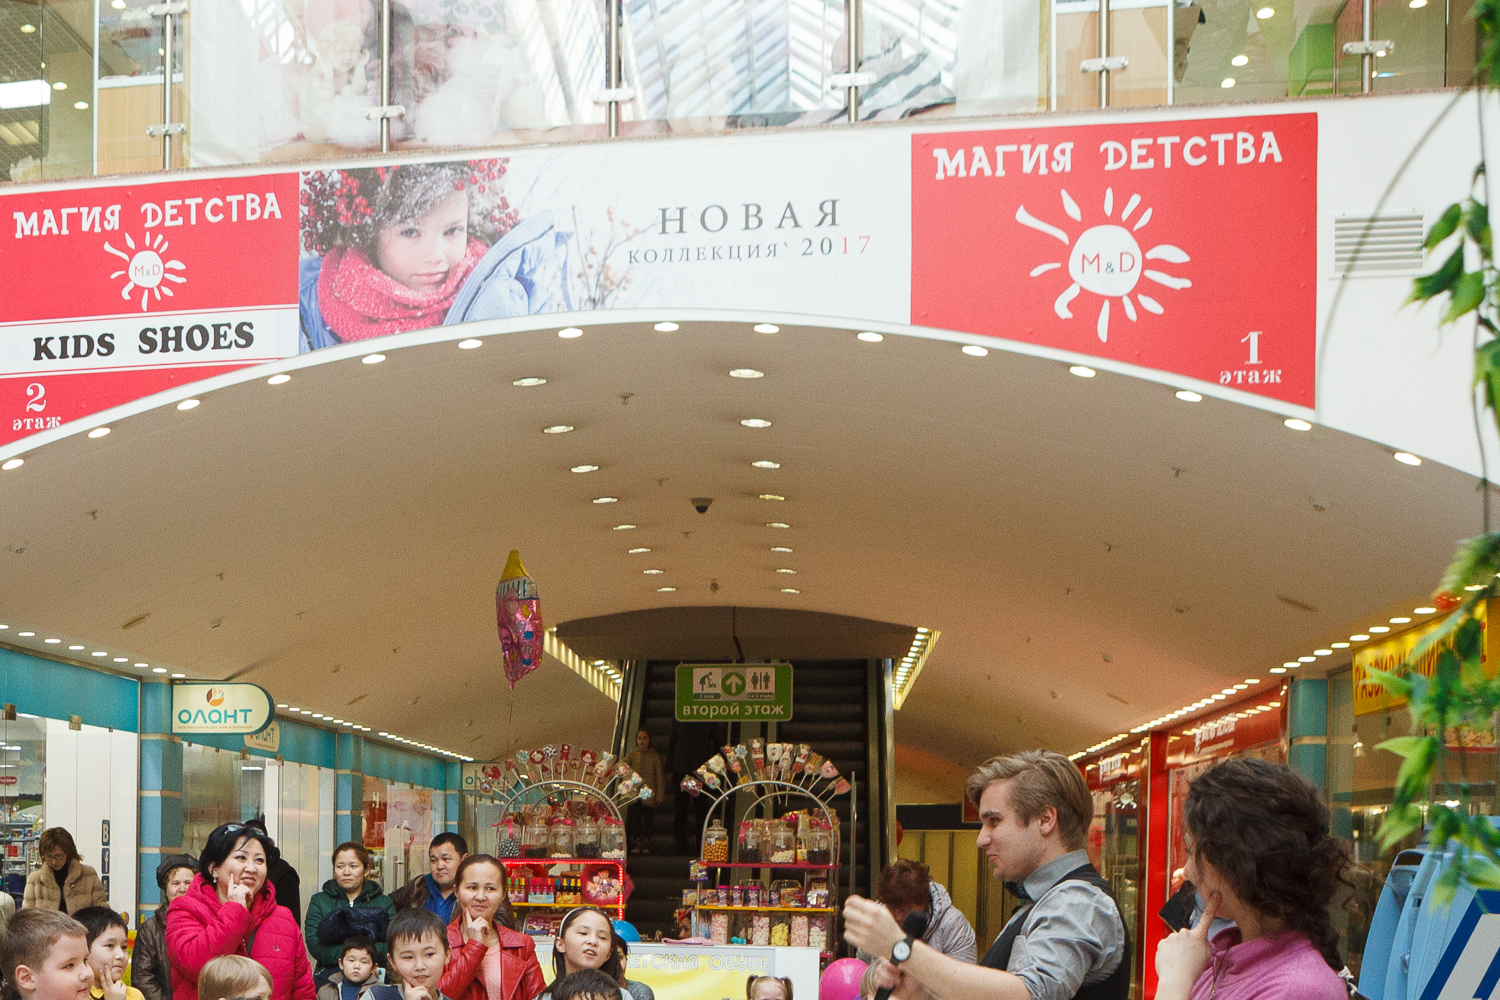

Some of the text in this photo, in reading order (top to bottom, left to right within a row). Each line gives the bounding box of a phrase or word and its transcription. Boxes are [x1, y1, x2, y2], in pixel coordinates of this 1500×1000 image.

[932, 131, 1283, 180] МАГИЯ ДЕТСТВА
[13, 192, 282, 239] МАГИЯ ДЕТСТВА
[657, 198, 840, 235] НОВАЯ
[801, 235, 871, 257] 2017
[32, 321, 254, 361] KIDS SHOES
[1240, 331, 1264, 365] 1
[1219, 368, 1282, 385] этаж
[26, 382, 47, 413] 2
[12, 415, 62, 431] этаж
[683, 702, 785, 719] второй этаж
